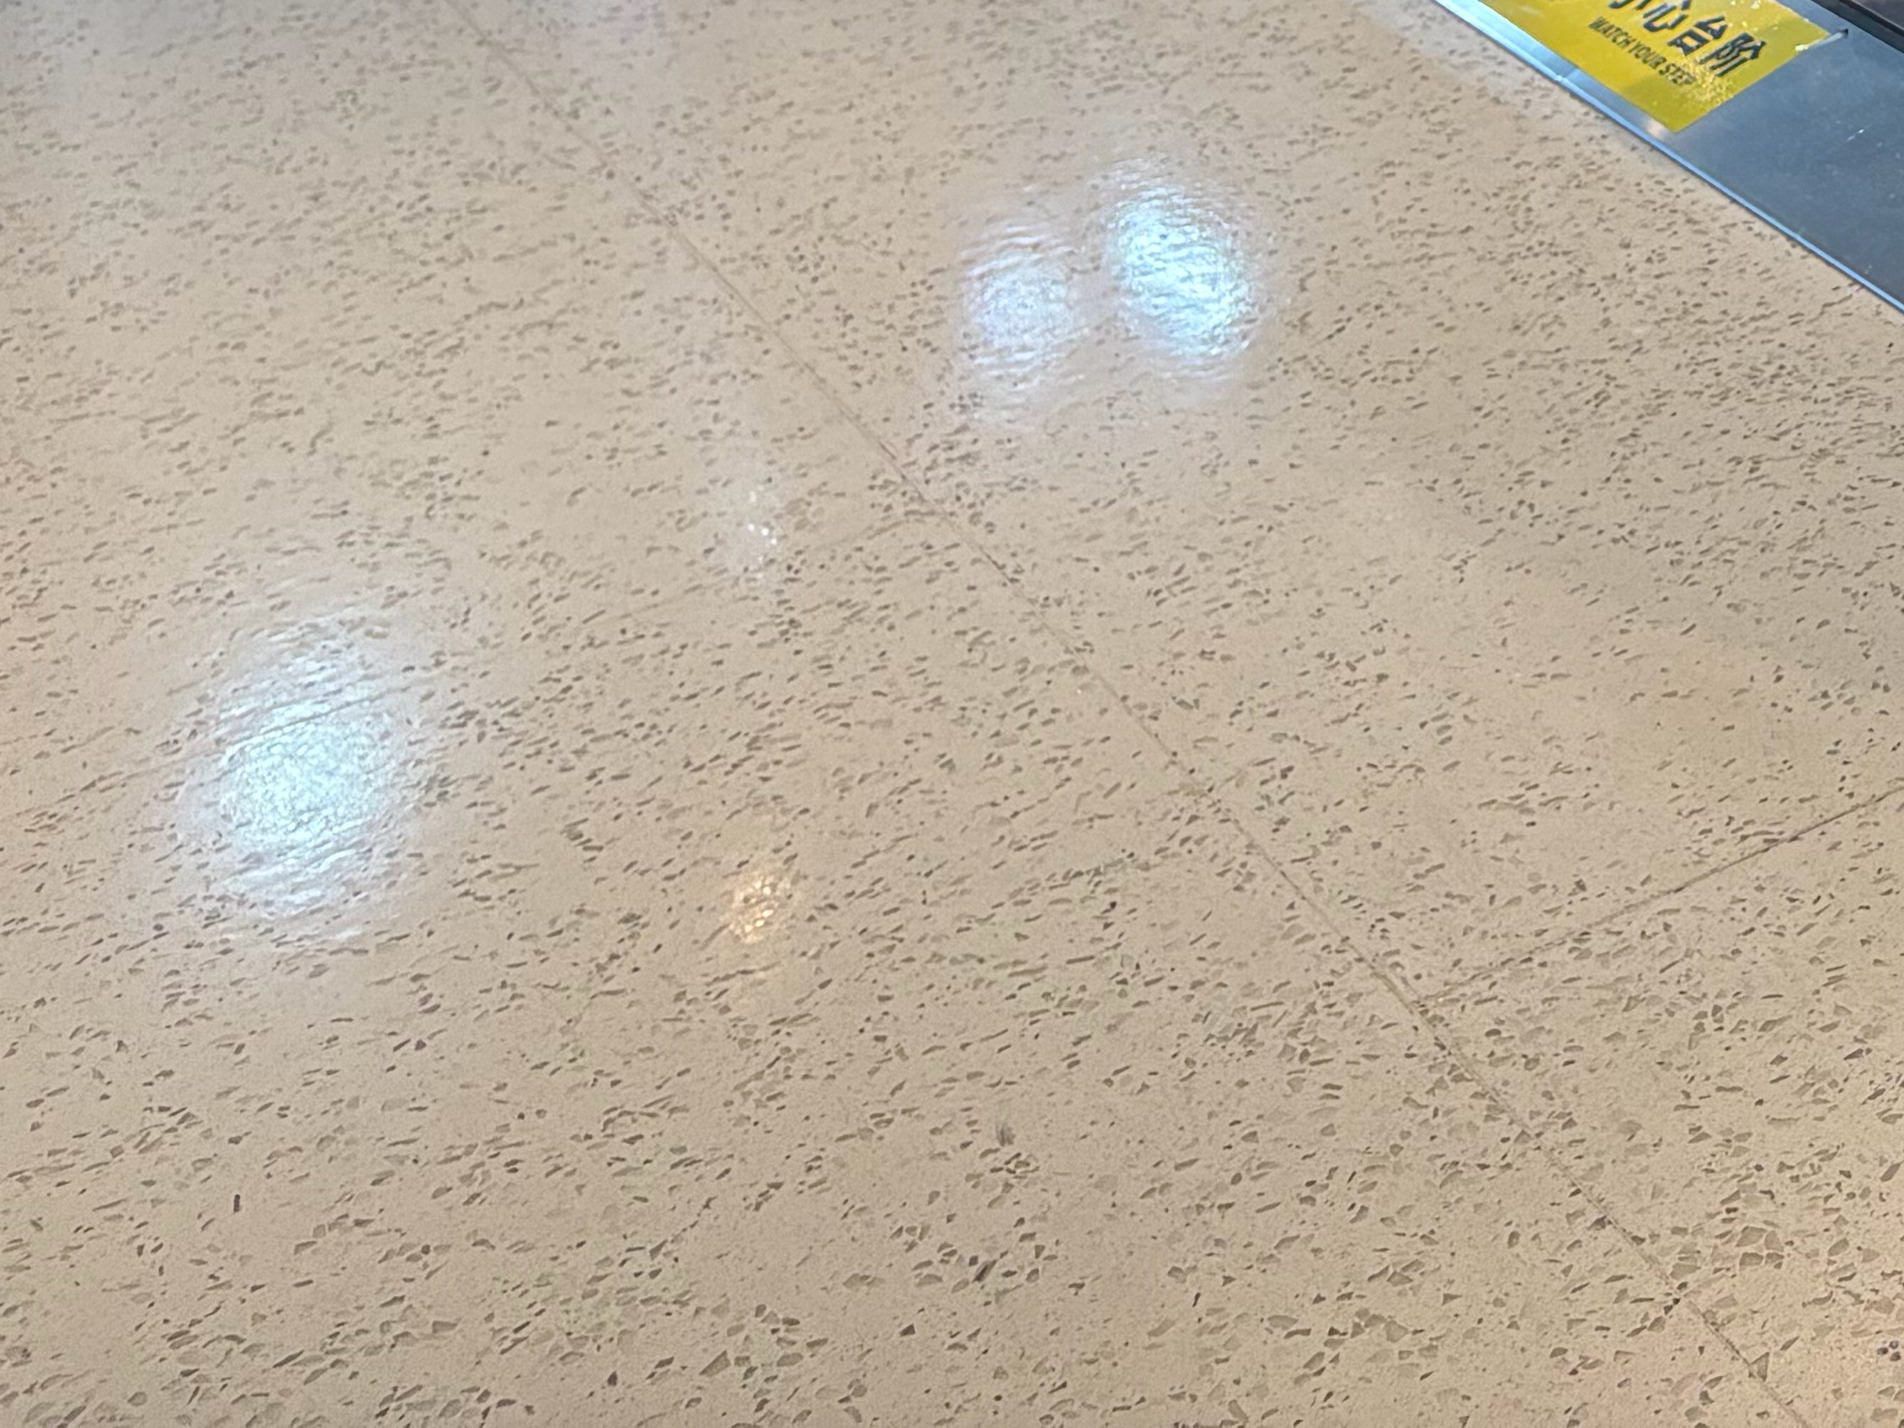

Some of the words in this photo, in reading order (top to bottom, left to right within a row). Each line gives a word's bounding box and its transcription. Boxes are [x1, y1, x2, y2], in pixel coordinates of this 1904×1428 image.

[1588, 15, 1634, 49] WATCH
[1628, 39, 1667, 70] YOUR
[1658, 61, 1697, 87] STEP
